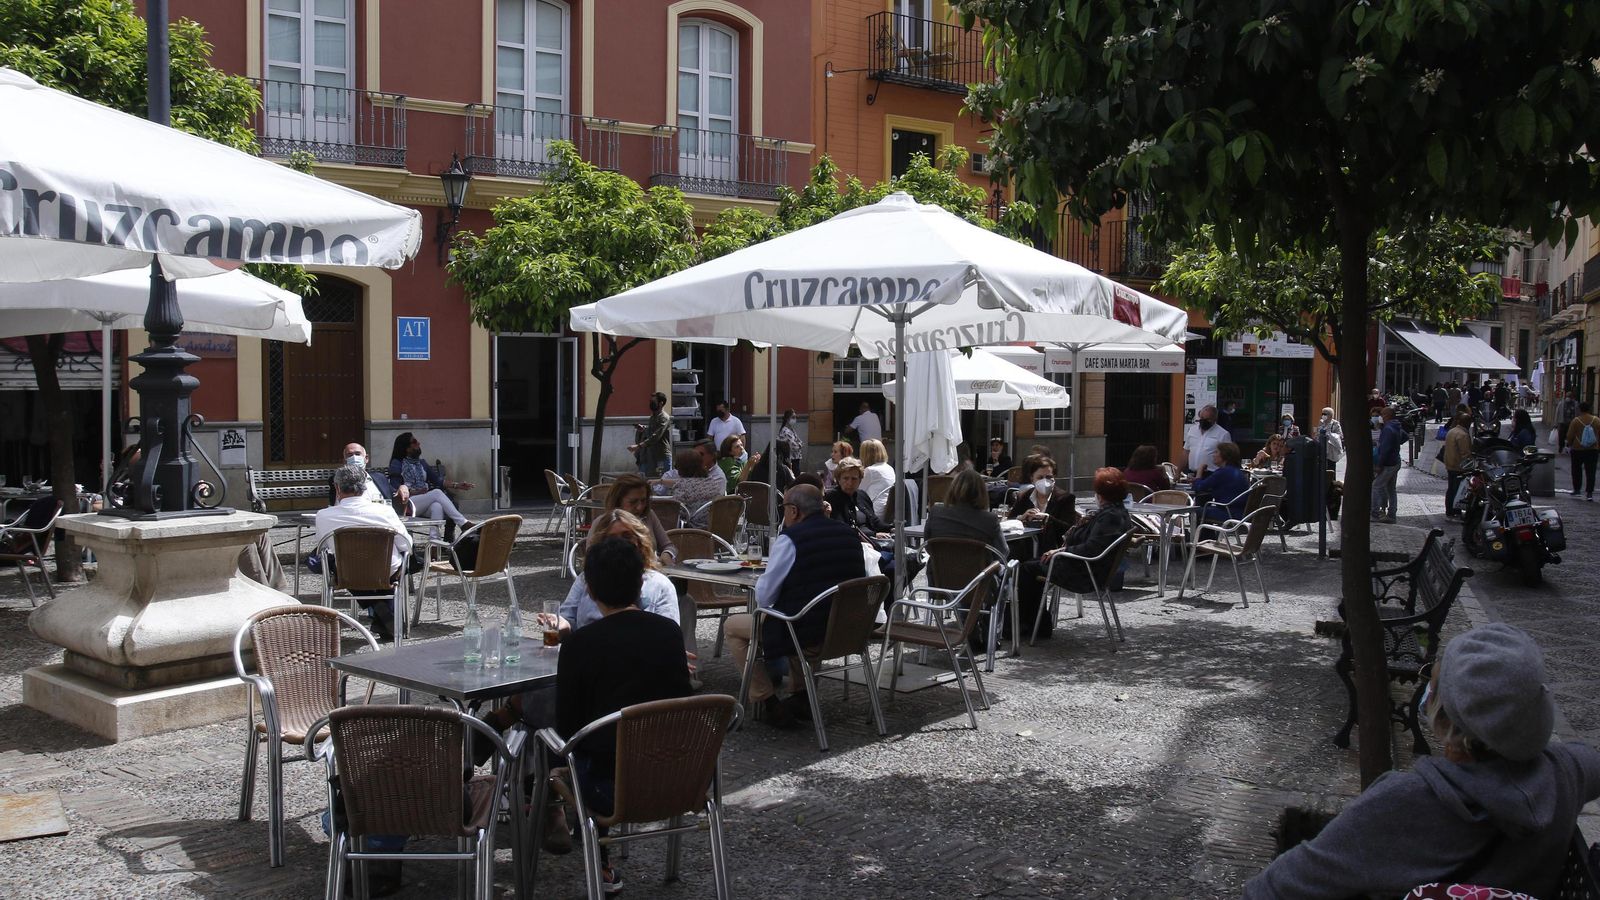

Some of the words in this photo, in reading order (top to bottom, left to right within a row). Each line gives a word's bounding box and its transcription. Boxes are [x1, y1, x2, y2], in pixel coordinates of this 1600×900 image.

[402, 321, 426, 337] AT
[1084, 357, 1100, 369] CAFE
[1100, 357, 1119, 369] SANTA
[1119, 358, 1139, 369] MARTA
[1139, 358, 1151, 369] BAR
